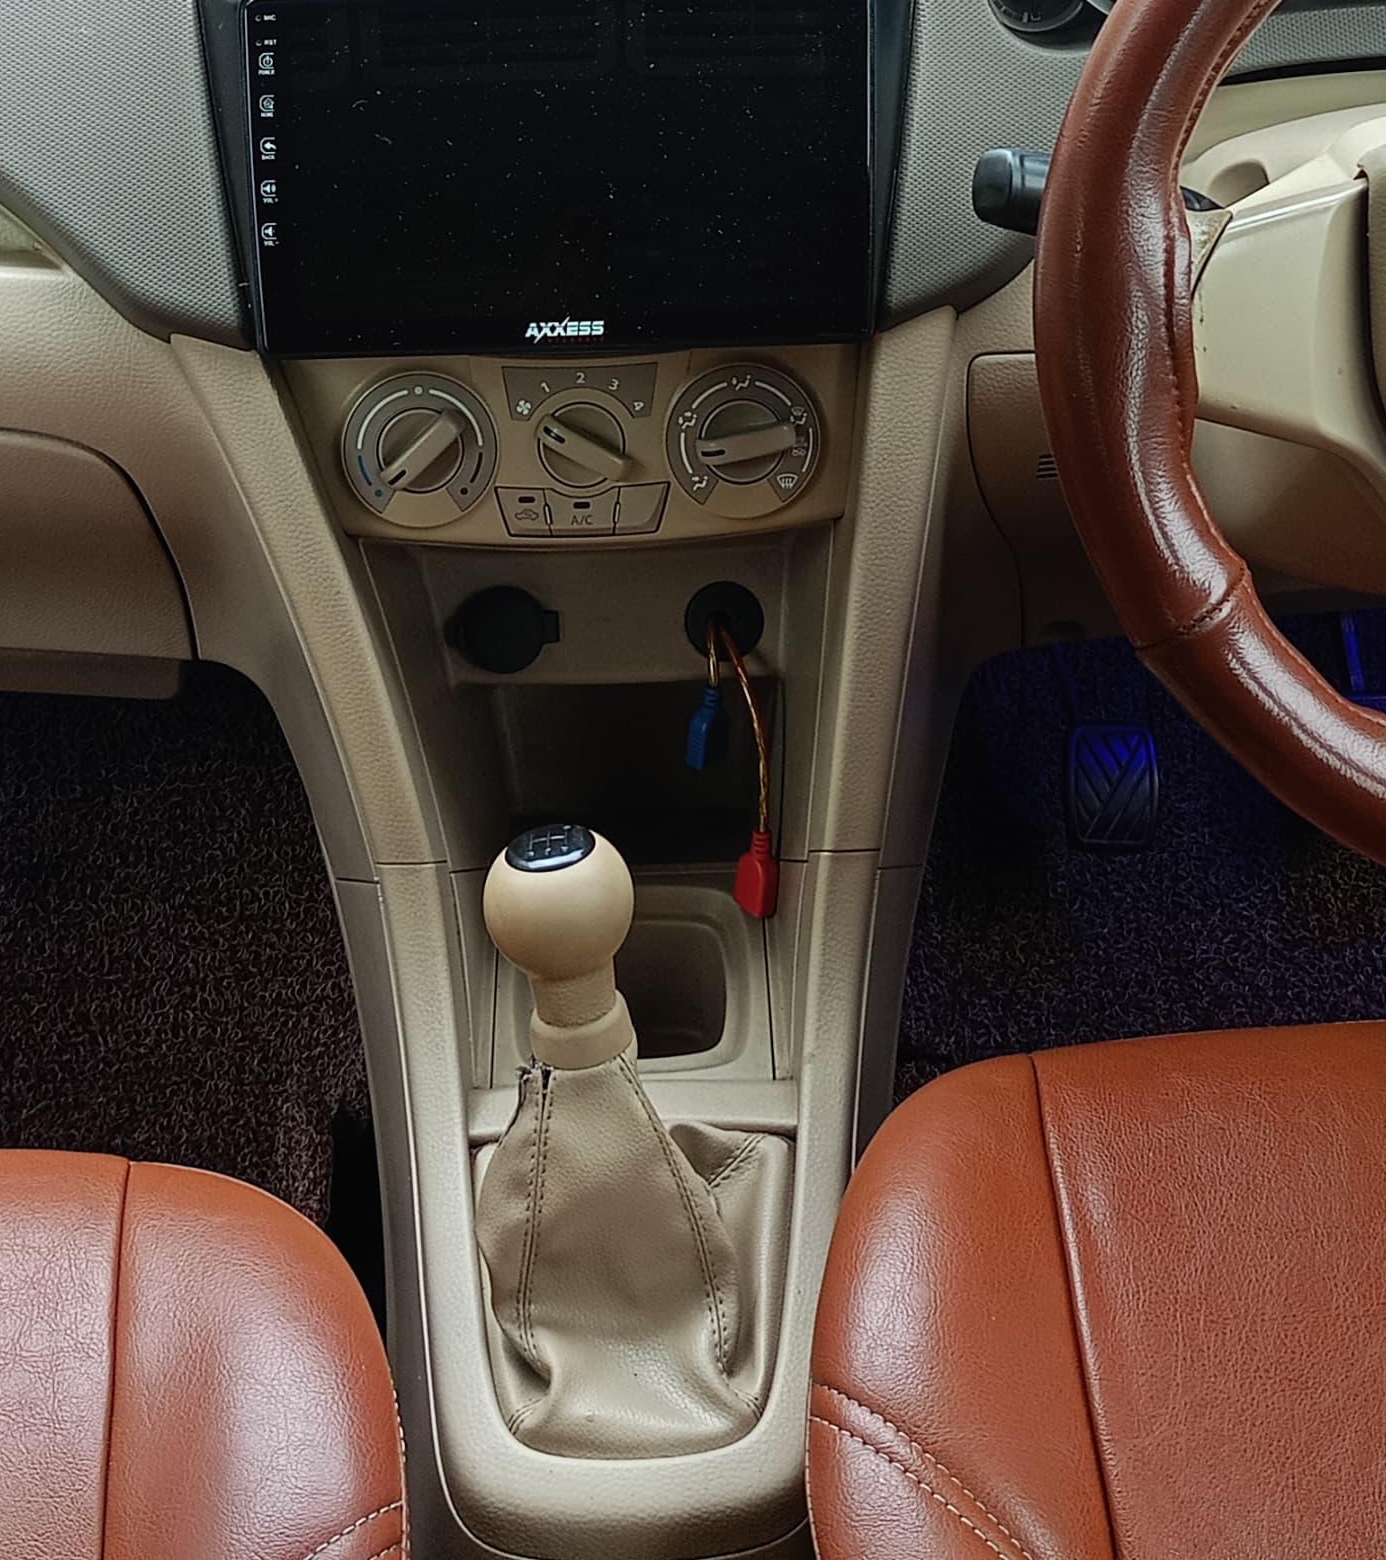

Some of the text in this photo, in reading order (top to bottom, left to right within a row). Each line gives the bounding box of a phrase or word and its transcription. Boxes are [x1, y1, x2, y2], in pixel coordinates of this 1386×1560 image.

[524, 316, 605, 344] AXXESS
[575, 372, 586, 384] 2
[540, 382, 550, 393] 1
[609, 379, 619, 391] 3
[633, 401, 644, 411] 4
[571, 515, 594, 526] A/C
